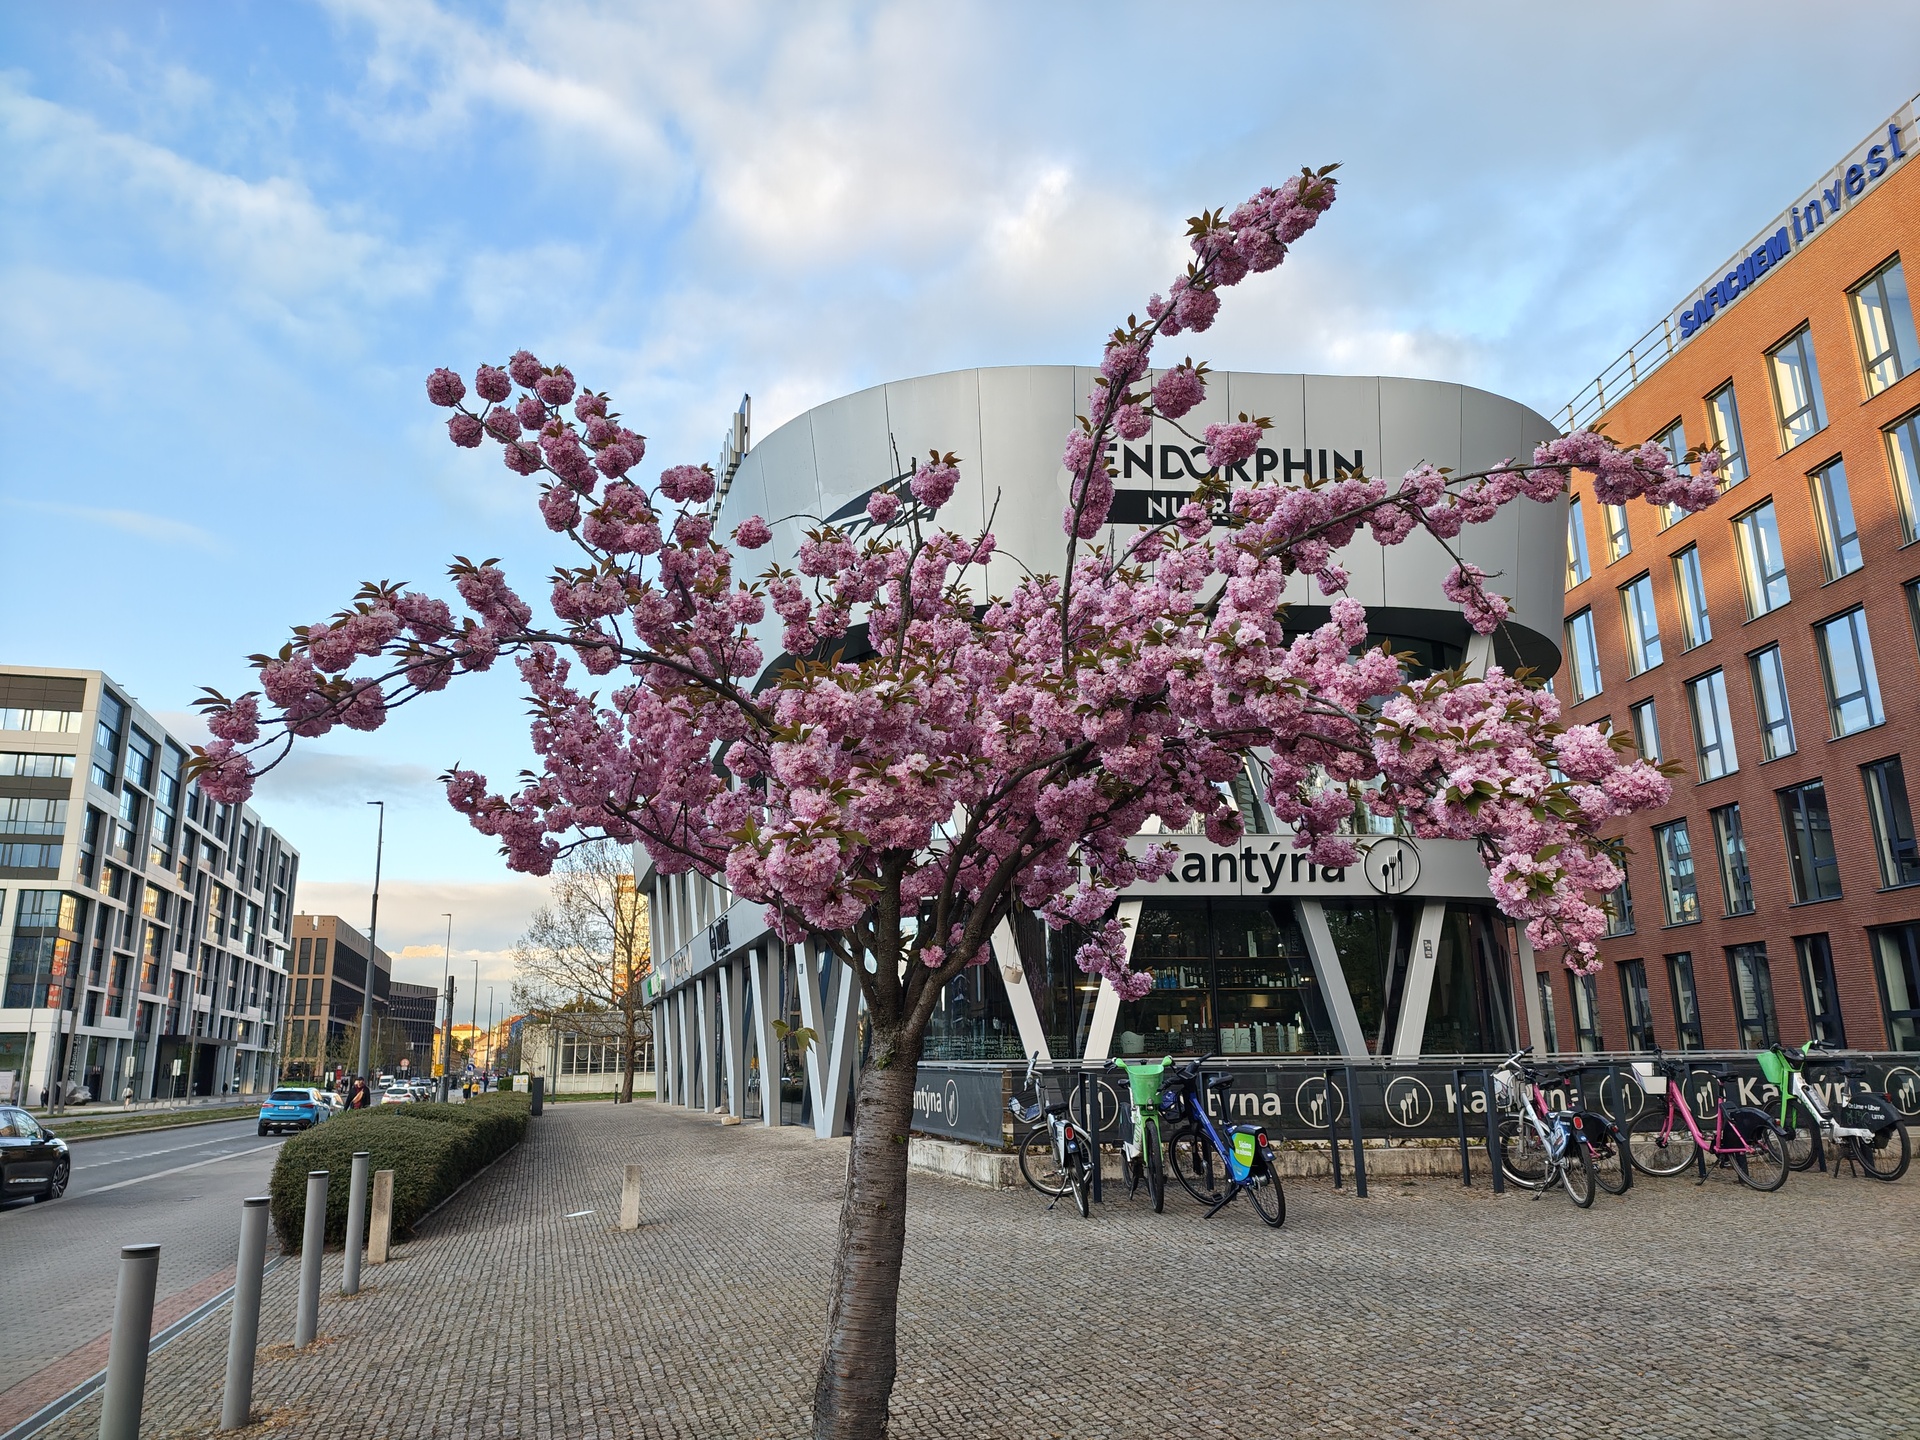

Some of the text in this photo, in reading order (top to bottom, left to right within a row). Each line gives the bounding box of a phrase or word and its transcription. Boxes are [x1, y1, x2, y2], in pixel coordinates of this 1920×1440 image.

[1680, 125, 1907, 339] SAFICHEM invest
[1165, 841, 1346, 894] antýna
